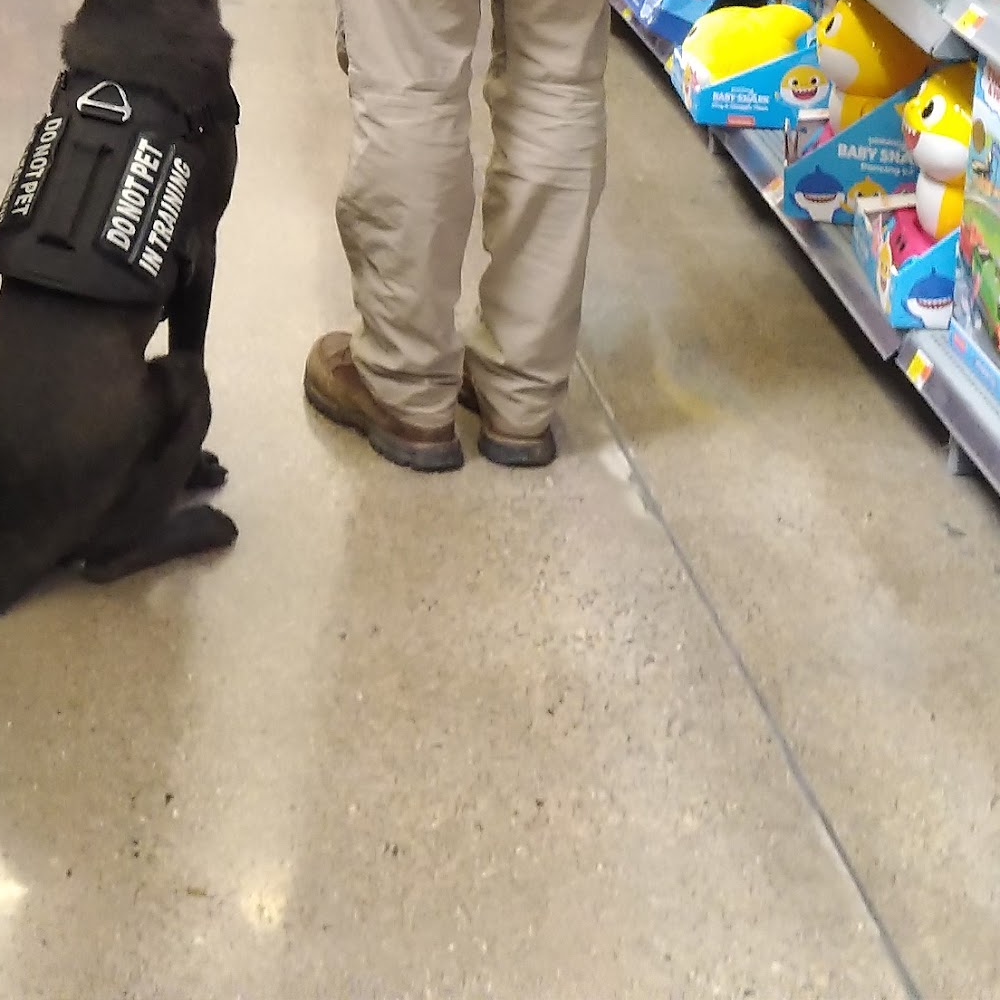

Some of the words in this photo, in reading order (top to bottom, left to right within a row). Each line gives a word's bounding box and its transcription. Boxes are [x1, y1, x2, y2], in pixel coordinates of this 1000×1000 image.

[40, 117, 63, 143] DO
[25, 143, 52, 179] NOT
[130, 138, 163, 183] PET
[837, 143, 878, 162] BABY
[11, 180, 39, 216] PET
[117, 177, 151, 223] NOT
[106, 217, 136, 250] DO
[138, 246, 162, 278] IN
[151, 157, 191, 251] TRAINING
